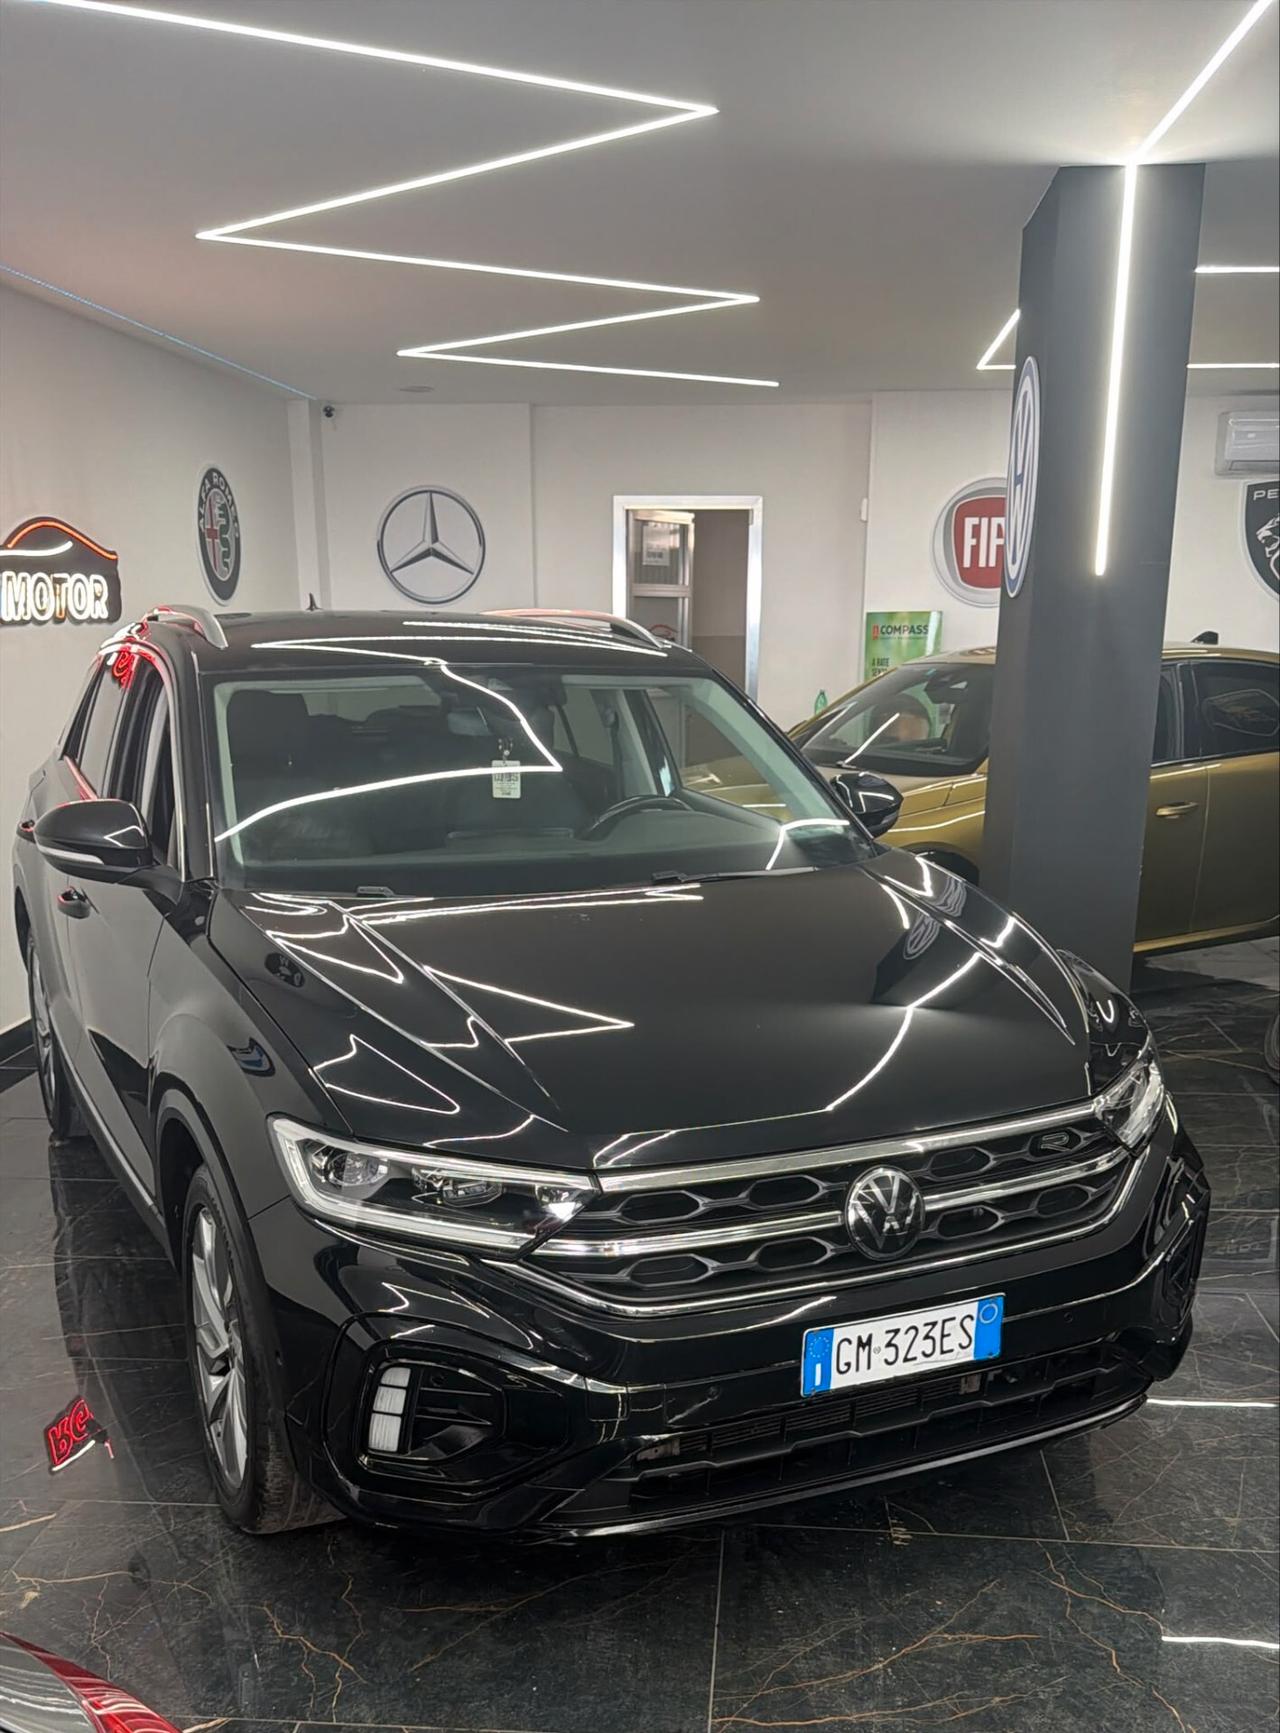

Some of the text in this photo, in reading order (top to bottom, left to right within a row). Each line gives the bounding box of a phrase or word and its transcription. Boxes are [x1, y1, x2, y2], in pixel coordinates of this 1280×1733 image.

[962, 516, 1005, 569] FIA
[1, 571, 109, 621] MOTOR
[880, 624, 930, 636] COMPASS
